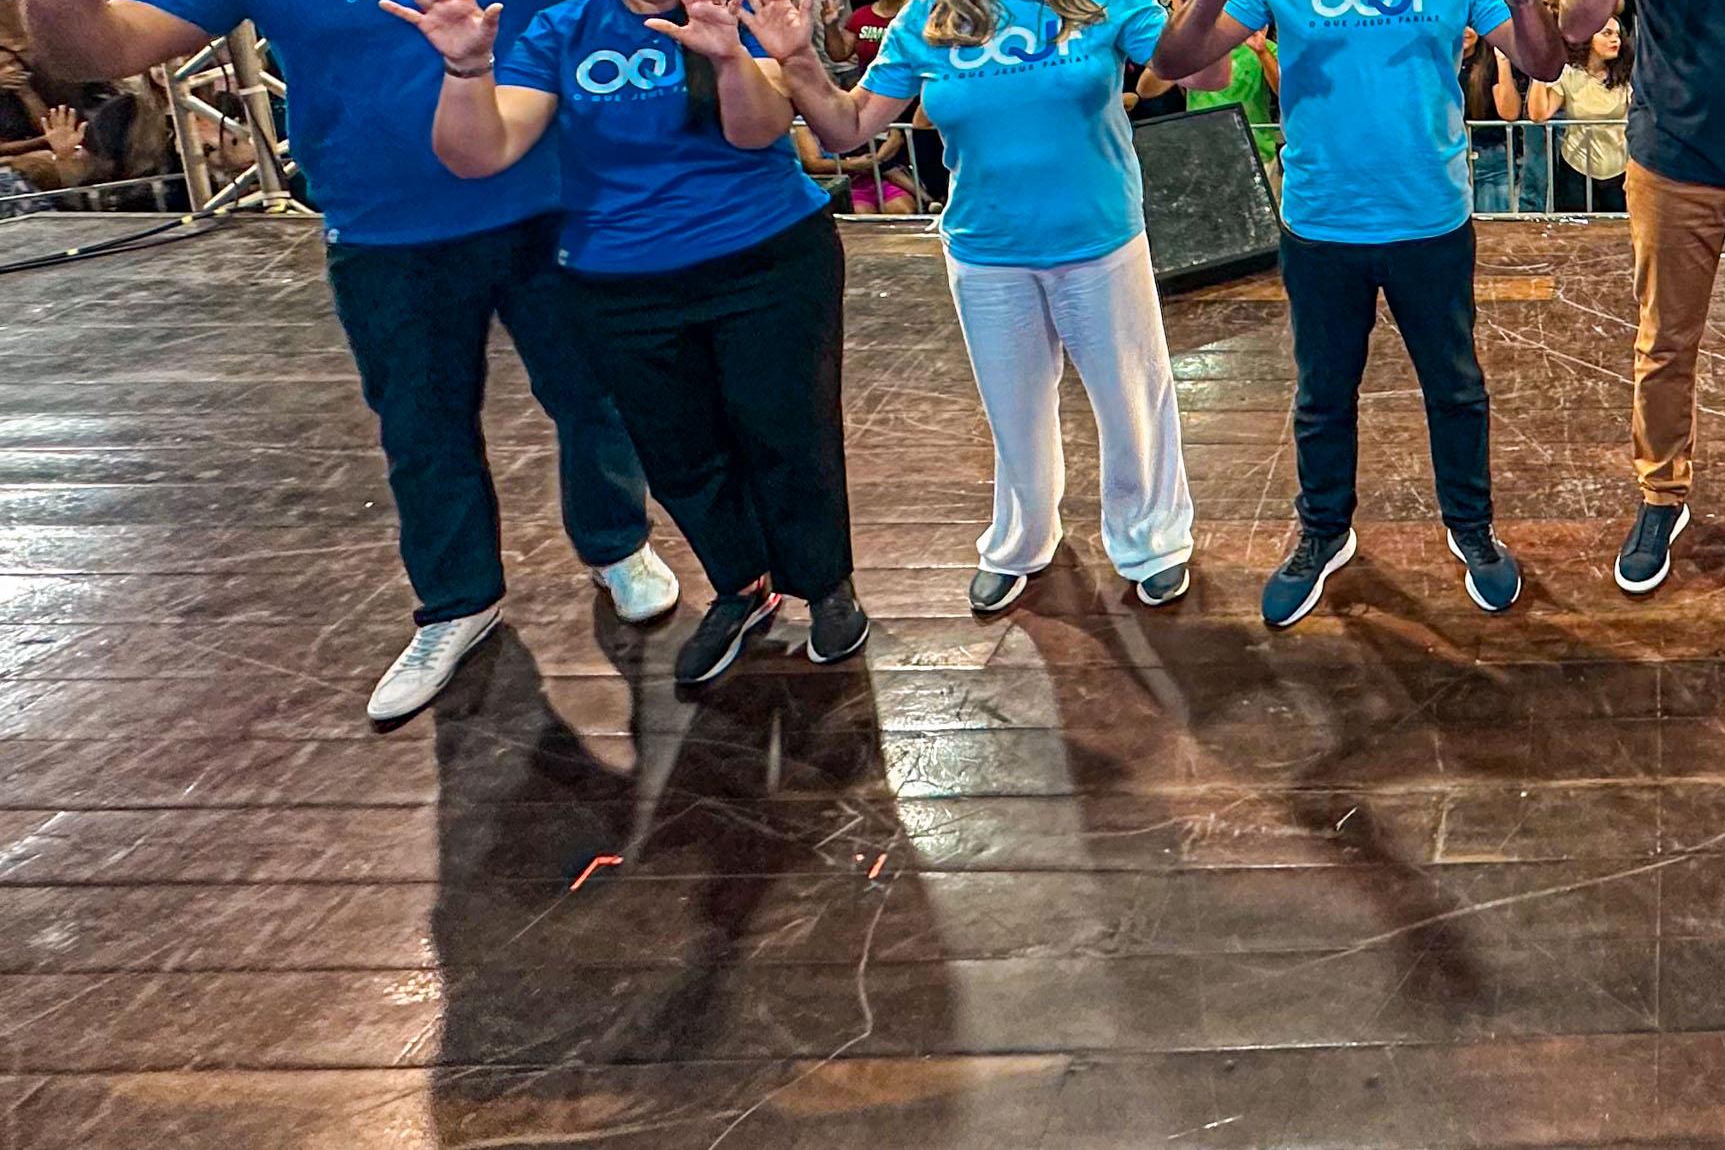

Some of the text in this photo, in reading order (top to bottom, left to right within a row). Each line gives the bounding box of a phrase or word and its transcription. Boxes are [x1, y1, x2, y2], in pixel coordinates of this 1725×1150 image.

[1323, 19, 1348, 28] QUE
[1354, 17, 1391, 28] JESUS
[957, 70, 985, 80] QUE
[994, 63, 1034, 77] JESUS
